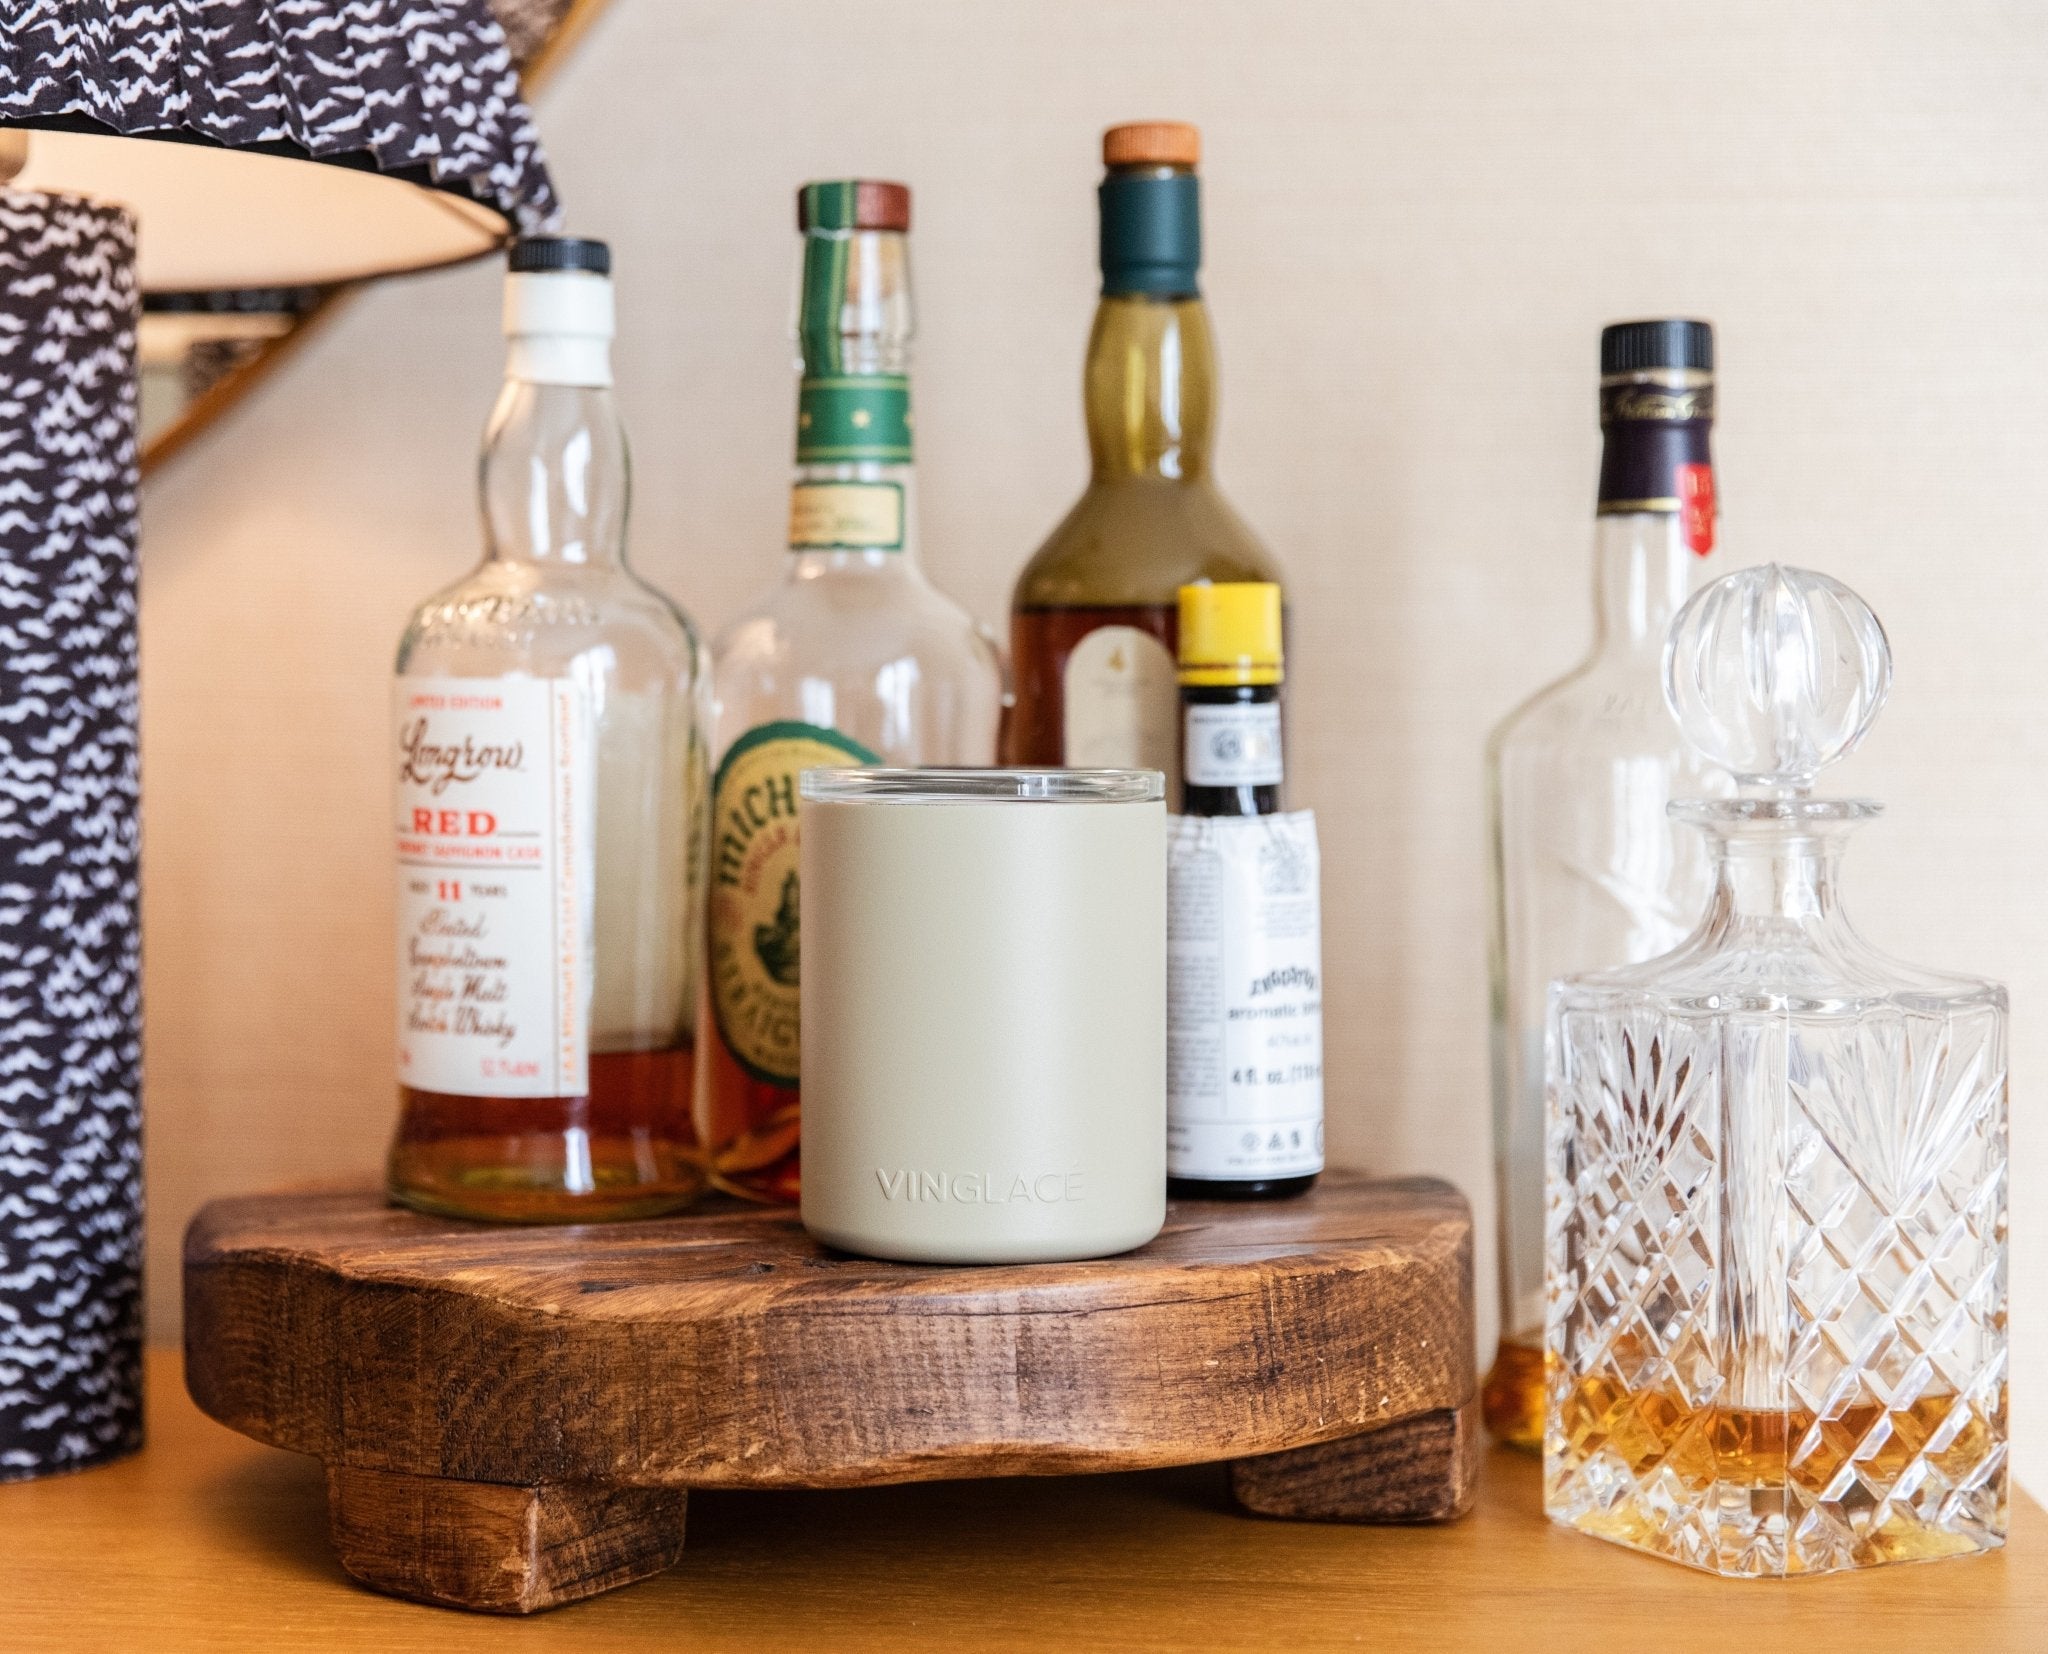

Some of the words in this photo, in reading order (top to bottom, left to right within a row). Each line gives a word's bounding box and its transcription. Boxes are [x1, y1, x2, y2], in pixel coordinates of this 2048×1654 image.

[400, 717, 525, 796] Longrow
[411, 807, 498, 837] RED
[437, 879, 462, 902] 11
